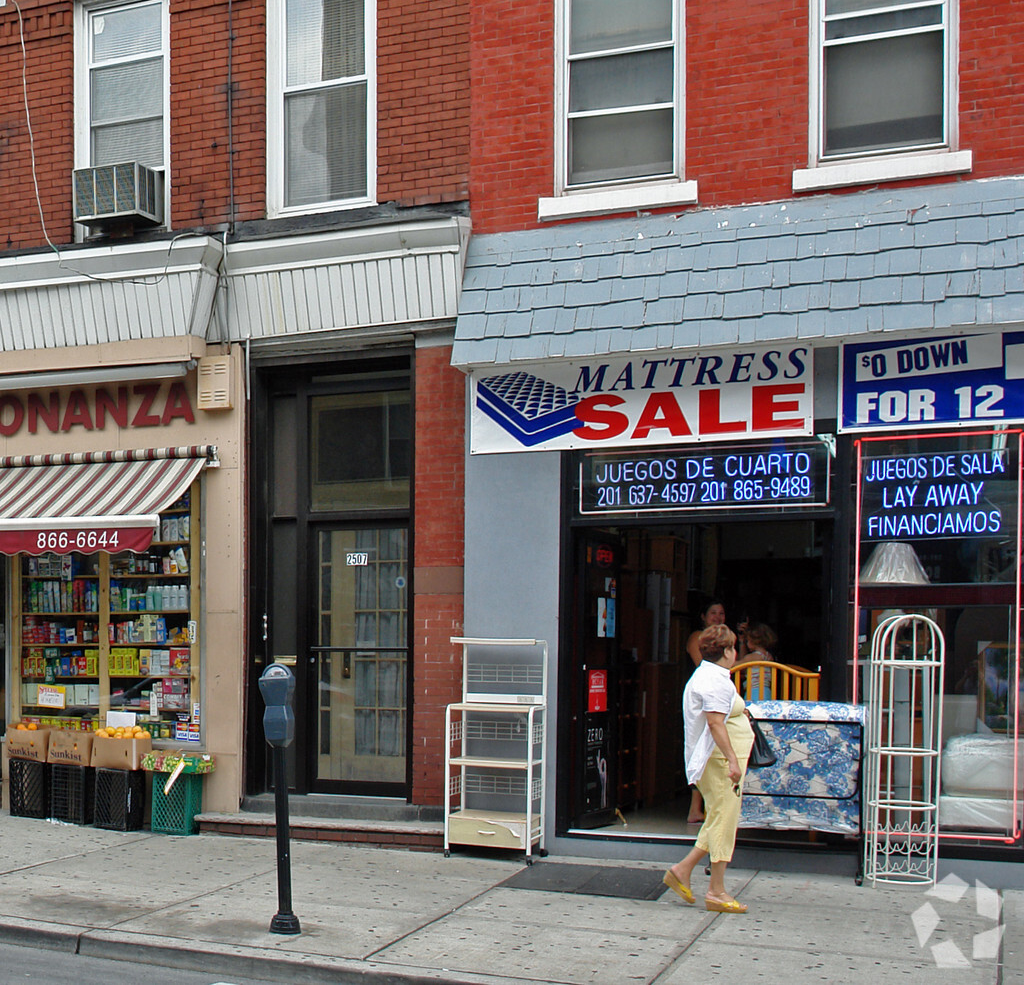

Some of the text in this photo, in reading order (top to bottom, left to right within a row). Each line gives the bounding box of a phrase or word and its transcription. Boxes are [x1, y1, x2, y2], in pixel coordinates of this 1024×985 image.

[574, 348, 808, 393] MATTRESS
[897, 339, 968, 375] DOWN
[572, 382, 807, 441] SALE
[856, 384, 1005, 424] FOR 12
[596, 451, 811, 484] JUEGOS DE CUARTO
[865, 452, 1005, 482] JUEGOS DE SALA
[597, 475, 811, 507] 201 637-4597 201 865-9489
[882, 481, 984, 509] LAY AWAY
[868, 510, 1002, 537] FINANCIAMOS
[36, 530, 119, 549] 866-6644
[347, 554, 367, 565] 2507
[587, 727, 604, 742] ZERO
[7, 746, 38, 759] Sunkist
[50, 750, 82, 762] Sunkist
